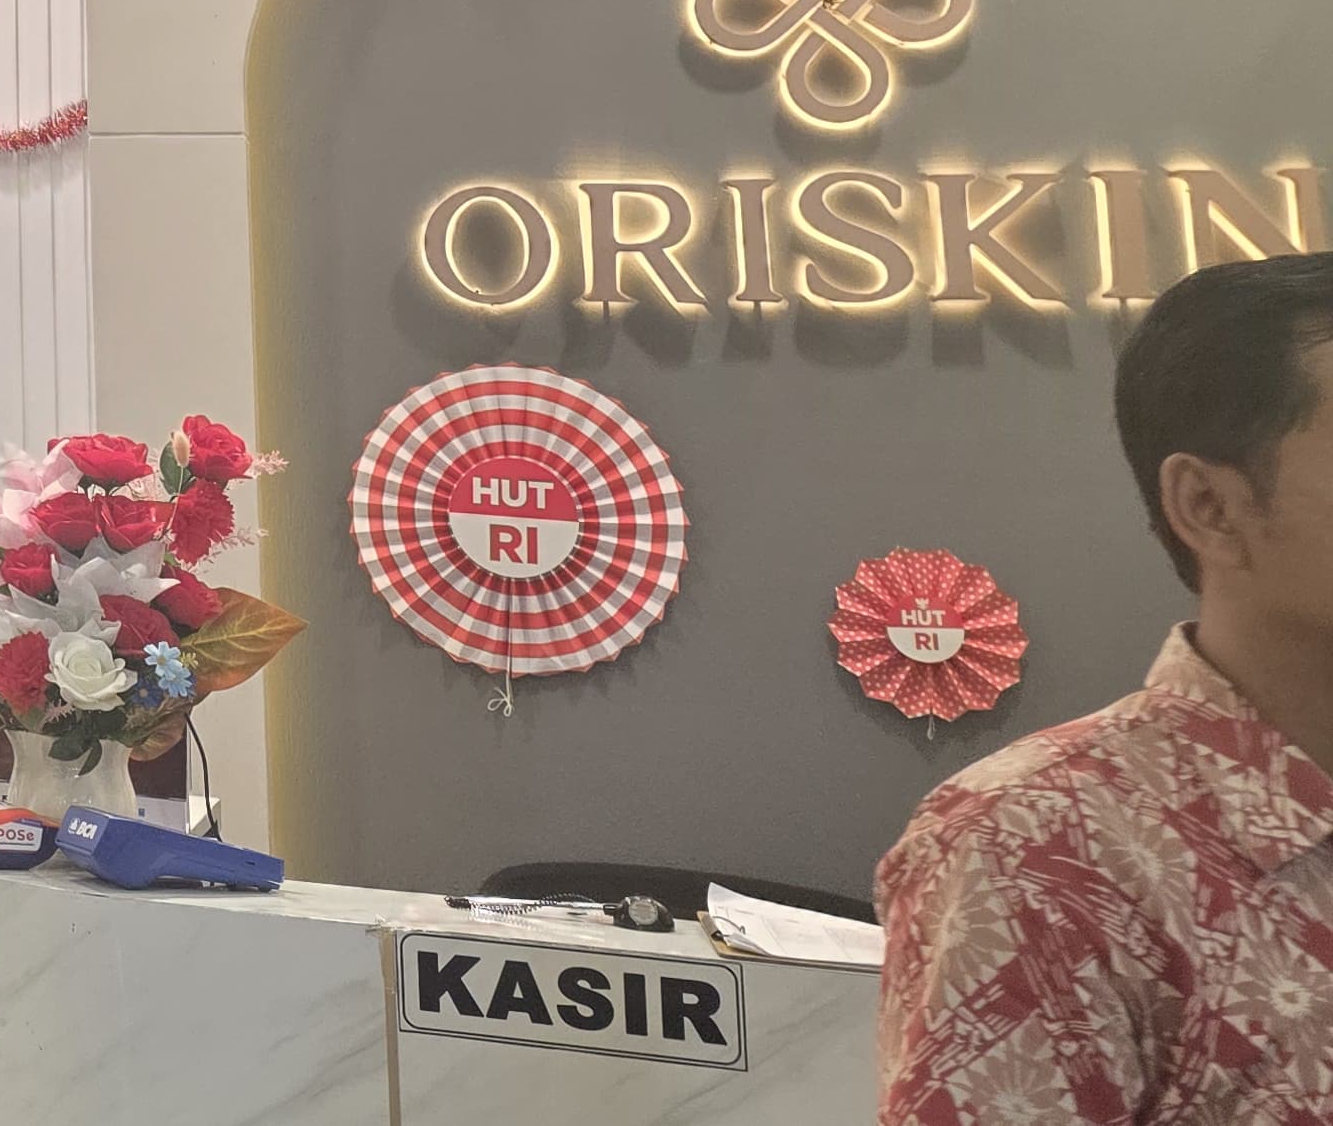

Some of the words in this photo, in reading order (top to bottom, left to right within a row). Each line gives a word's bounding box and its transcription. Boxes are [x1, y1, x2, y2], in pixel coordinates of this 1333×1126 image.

[423, 168, 1325, 307] ORISKIN
[472, 477, 555, 509] HUT
[489, 523, 539, 565] RI
[901, 609, 946, 627] HUT
[914, 632, 939, 650] RI
[76, 821, 98, 840] BCA
[417, 950, 728, 1047] KASIR
